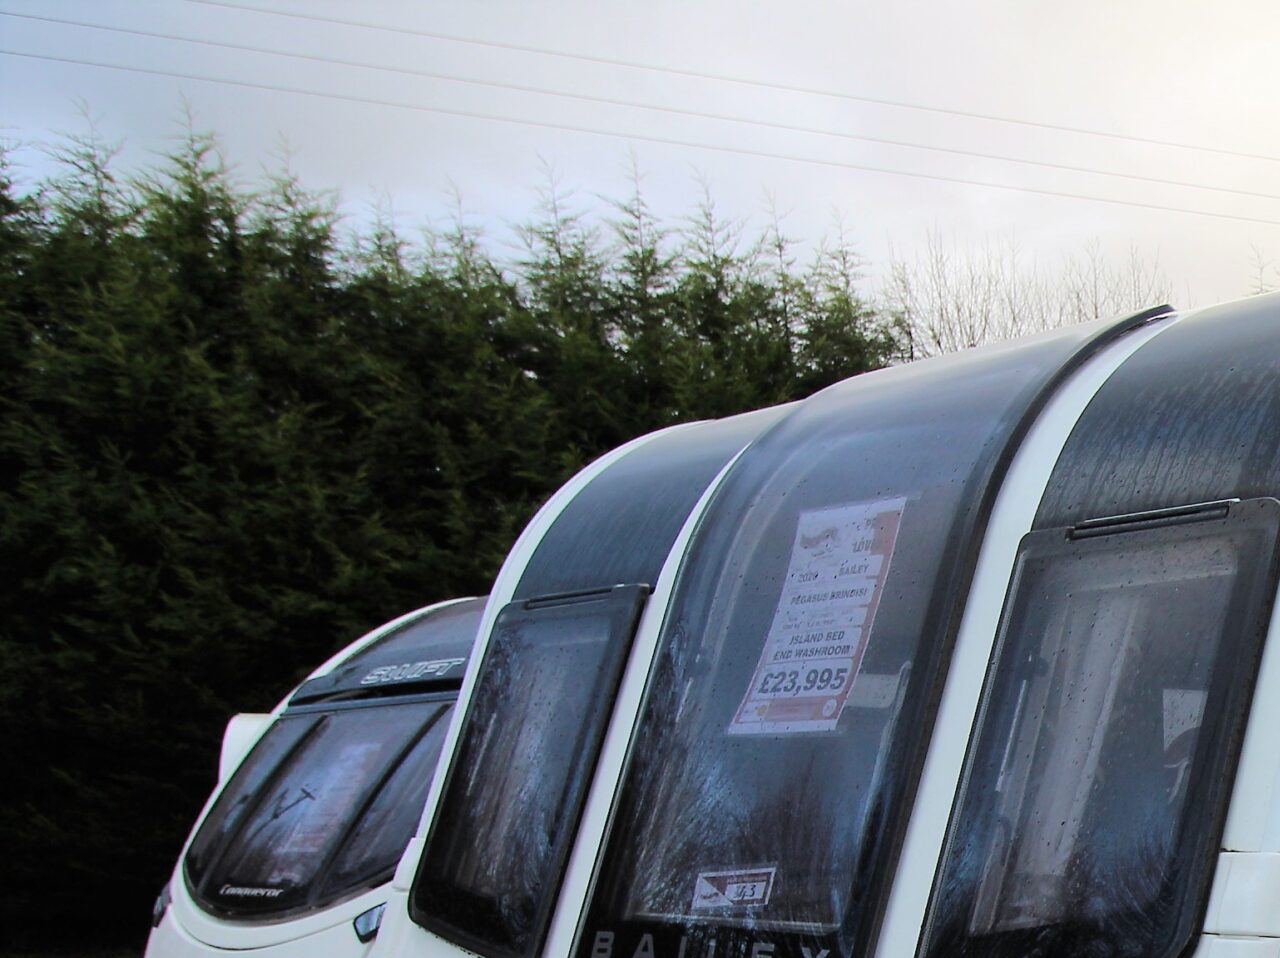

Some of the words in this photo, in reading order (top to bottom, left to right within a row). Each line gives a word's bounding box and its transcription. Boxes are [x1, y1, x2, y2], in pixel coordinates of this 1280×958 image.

[788, 632, 824, 646] ISLAND
[825, 631, 845, 641] BED
[794, 645, 851, 659] WASHROOM
[360, 657, 466, 686] SWIFT
[758, 668, 848, 696] £23,995
[219, 884, 284, 898] Conqueror
